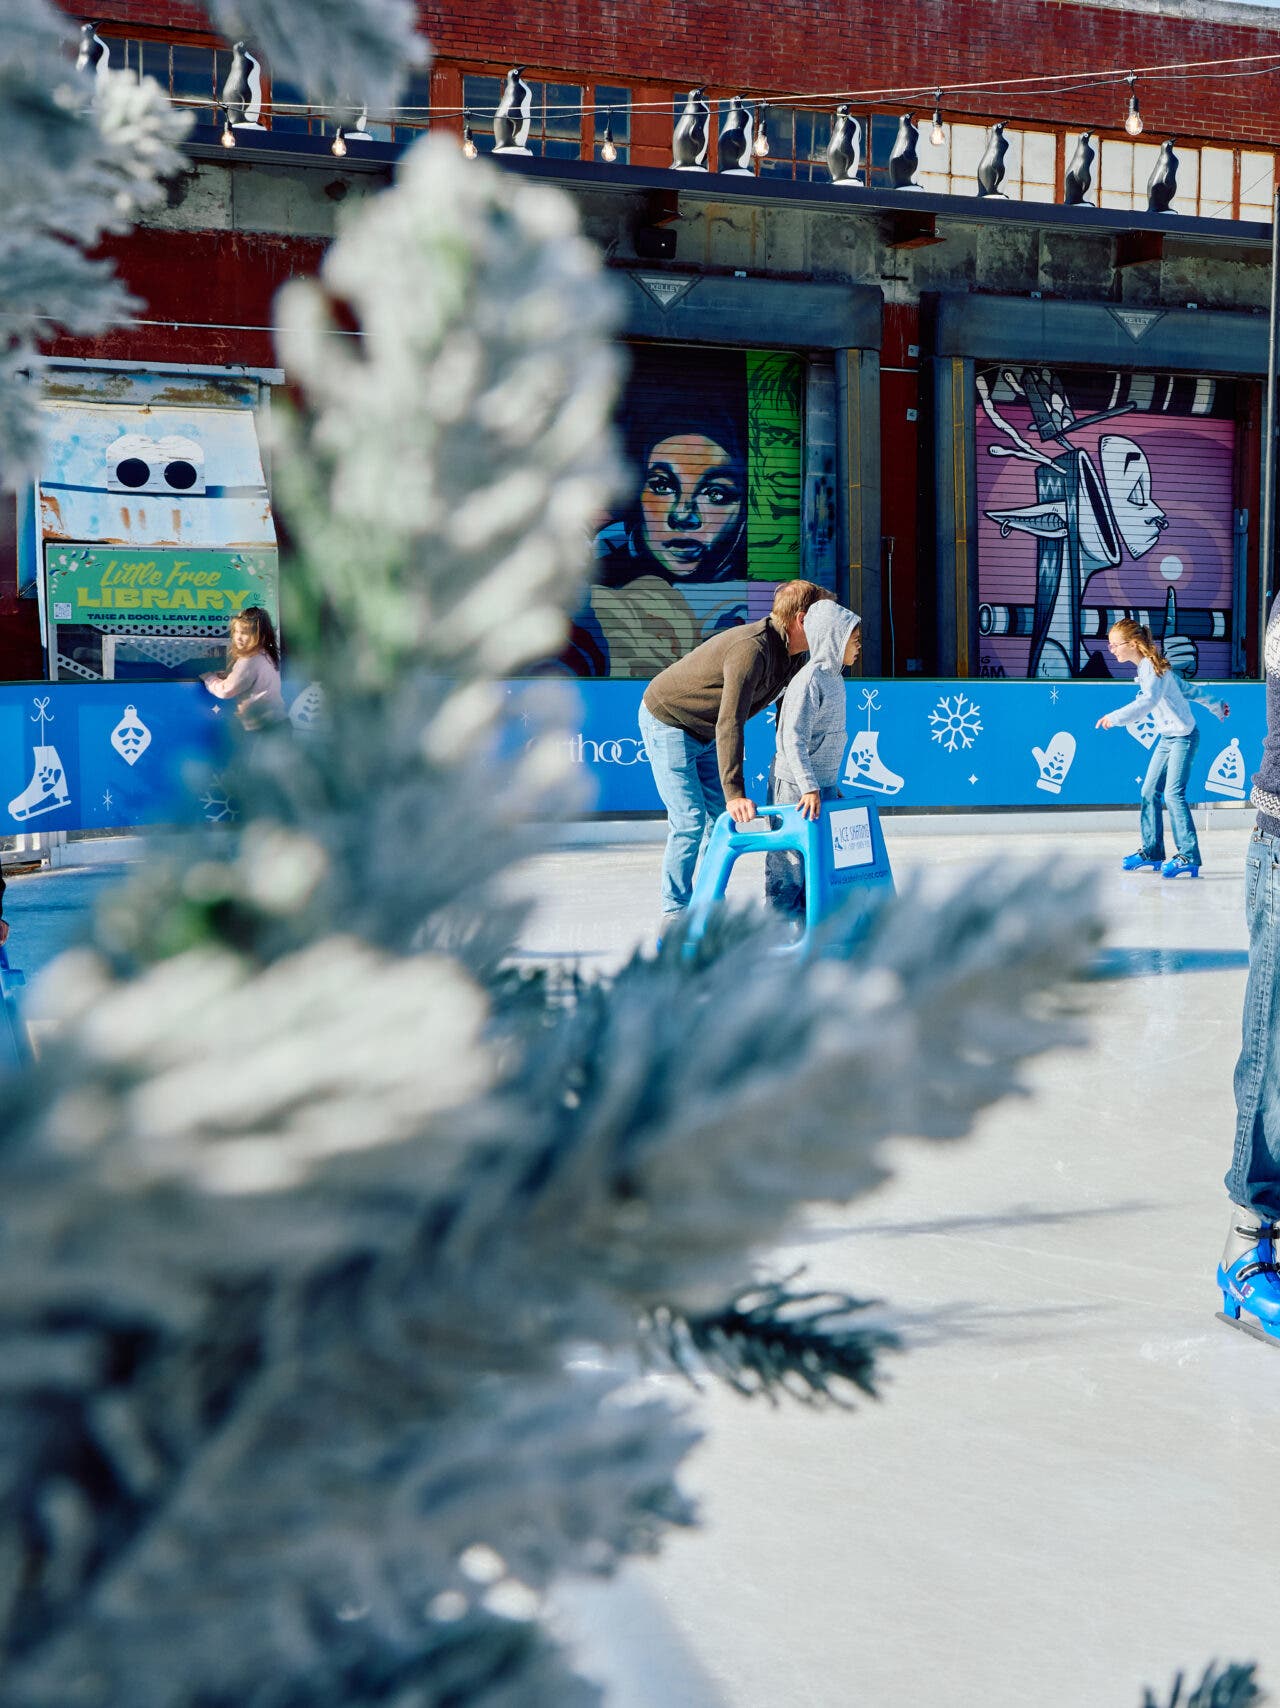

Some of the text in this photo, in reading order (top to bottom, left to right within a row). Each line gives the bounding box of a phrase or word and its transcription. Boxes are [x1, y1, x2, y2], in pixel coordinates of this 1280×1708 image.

[650, 283, 680, 292] KELLEY
[1124, 317, 1150, 325] KELLEY
[100, 560, 222, 587] Little Free
[77, 587, 252, 610] LIBRARY
